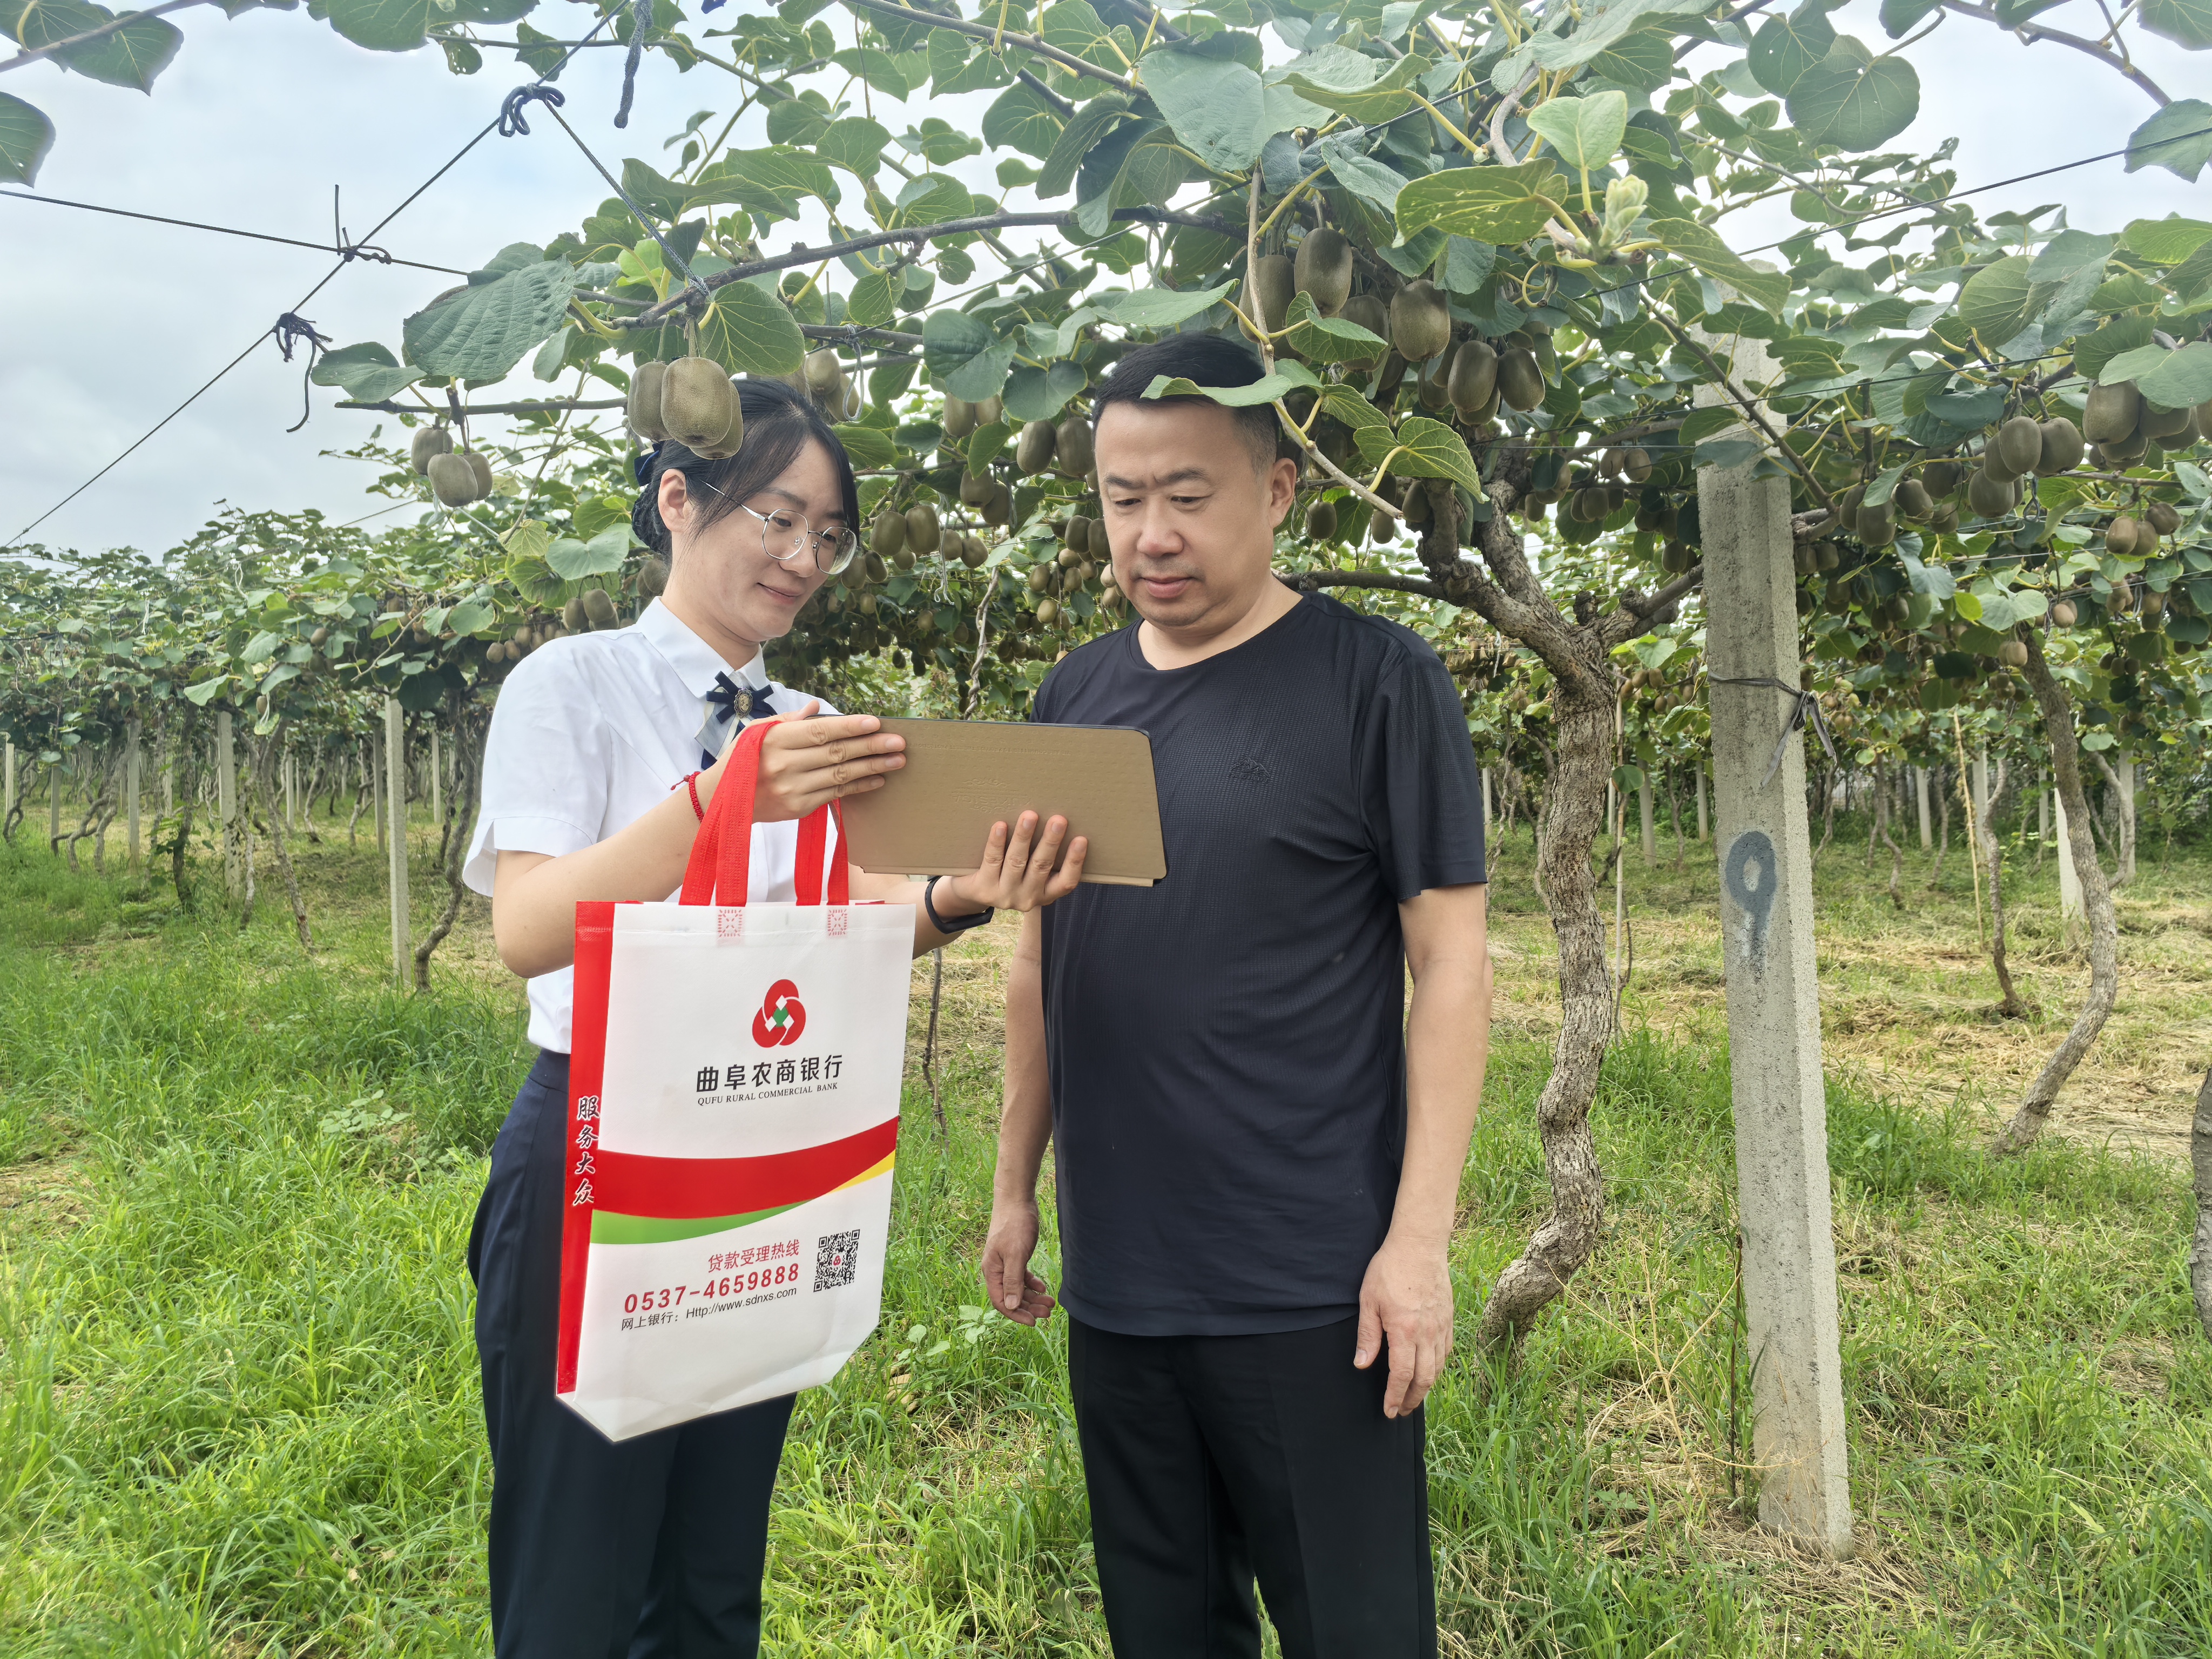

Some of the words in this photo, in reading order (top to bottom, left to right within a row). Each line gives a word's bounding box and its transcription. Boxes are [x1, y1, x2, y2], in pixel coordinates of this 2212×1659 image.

[696, 1054, 843, 1092] 曲阜农商银行
[697, 1095, 724, 1106] QUFU
[725, 1092, 756, 1103] RURAL
[758, 1085, 813, 1100] COMMERCIAL
[817, 1082, 838, 1092] BANK
[572, 1095, 600, 1206] 服务大众
[707, 1238, 800, 1273] 贷款受理热线
[624, 1263, 799, 1314] 0537-4659888
[686, 1286, 797, 1319] Http://www.sdnxs.com
